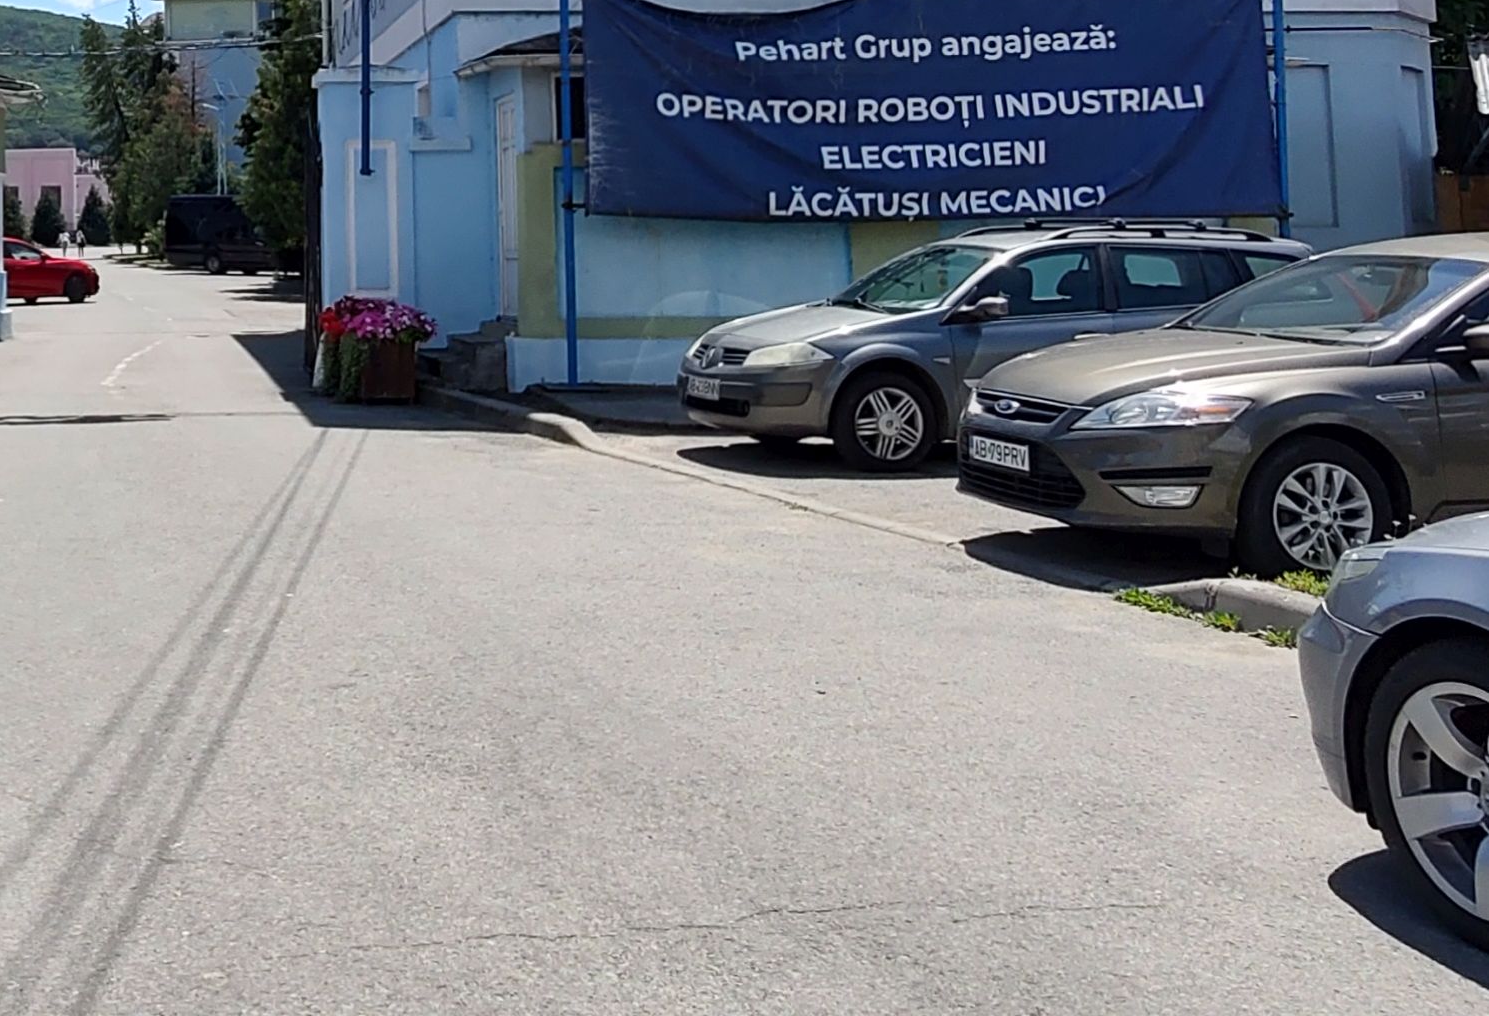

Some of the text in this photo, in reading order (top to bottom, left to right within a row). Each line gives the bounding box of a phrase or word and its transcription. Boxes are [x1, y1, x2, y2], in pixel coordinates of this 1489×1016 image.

[734, 23, 1118, 64] Pehart Grup angajează:
[656, 84, 1205, 128] OPERATORI ROBOȚI INDUSTRIALI
[820, 139, 1047, 170] ELECTRICIENI
[768, 185, 1107, 223] LĂCĂTUȘI MECANICI
